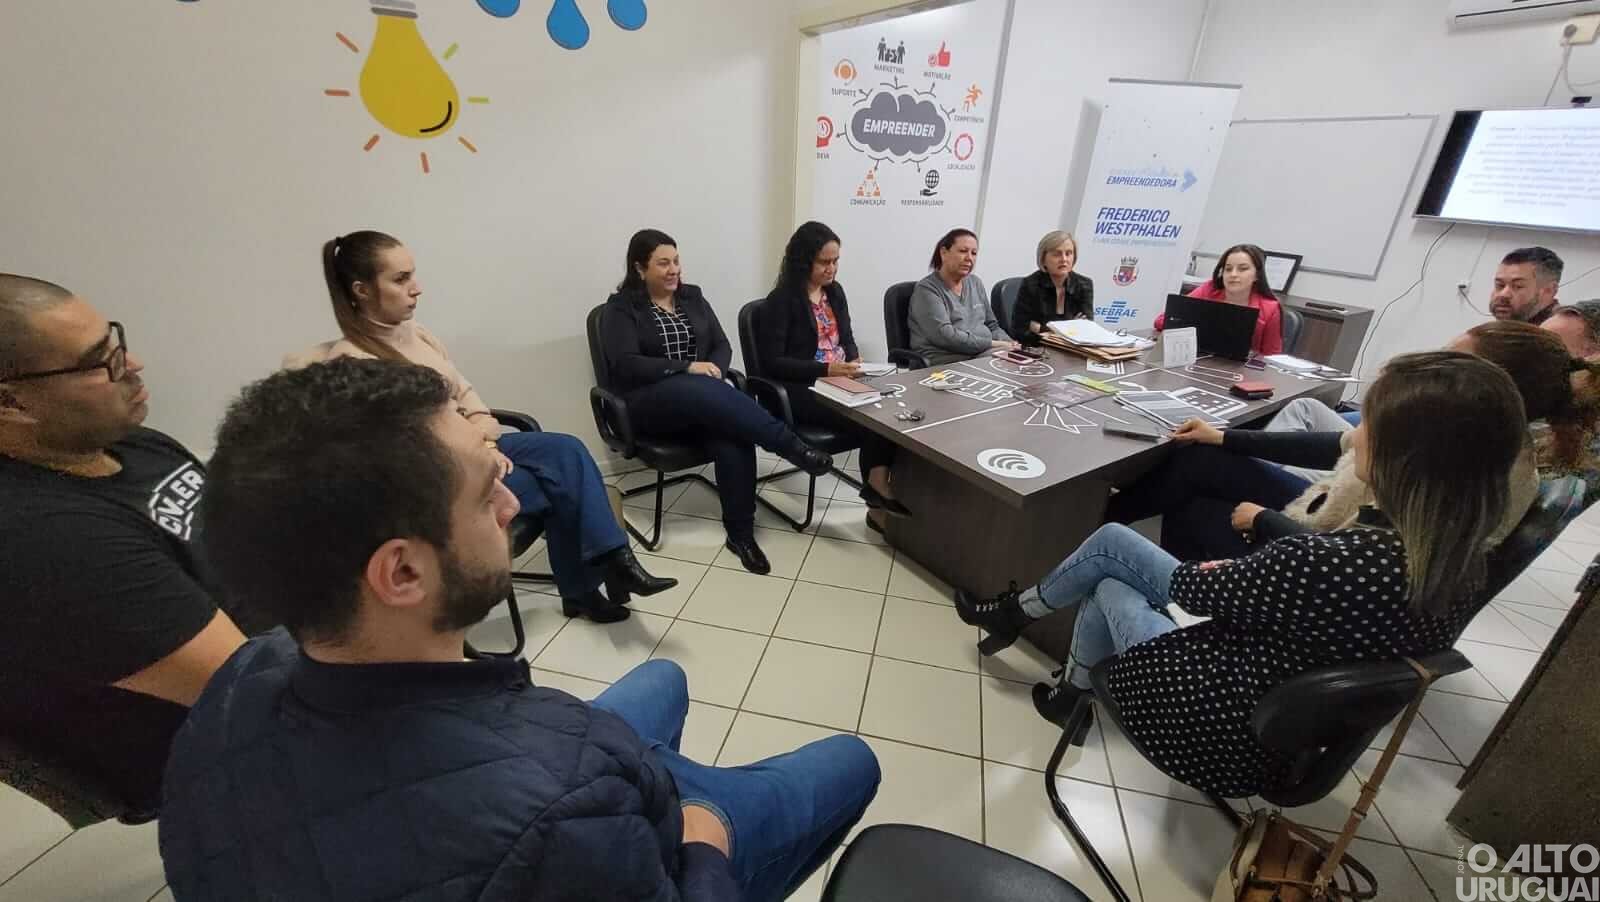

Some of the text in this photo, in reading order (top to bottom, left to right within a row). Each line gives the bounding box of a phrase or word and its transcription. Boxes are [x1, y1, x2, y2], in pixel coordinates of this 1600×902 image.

[874, 64, 904, 74] MARKETING
[832, 87, 857, 97] SUPORTE
[863, 118, 936, 137] EMPREENDER
[1106, 175, 1178, 188] EMPREENDEDORA
[1097, 207, 1170, 223] FREDERICO
[1095, 222, 1182, 238] WESTPHALEN
[1095, 307, 1137, 318] SEBRAE
